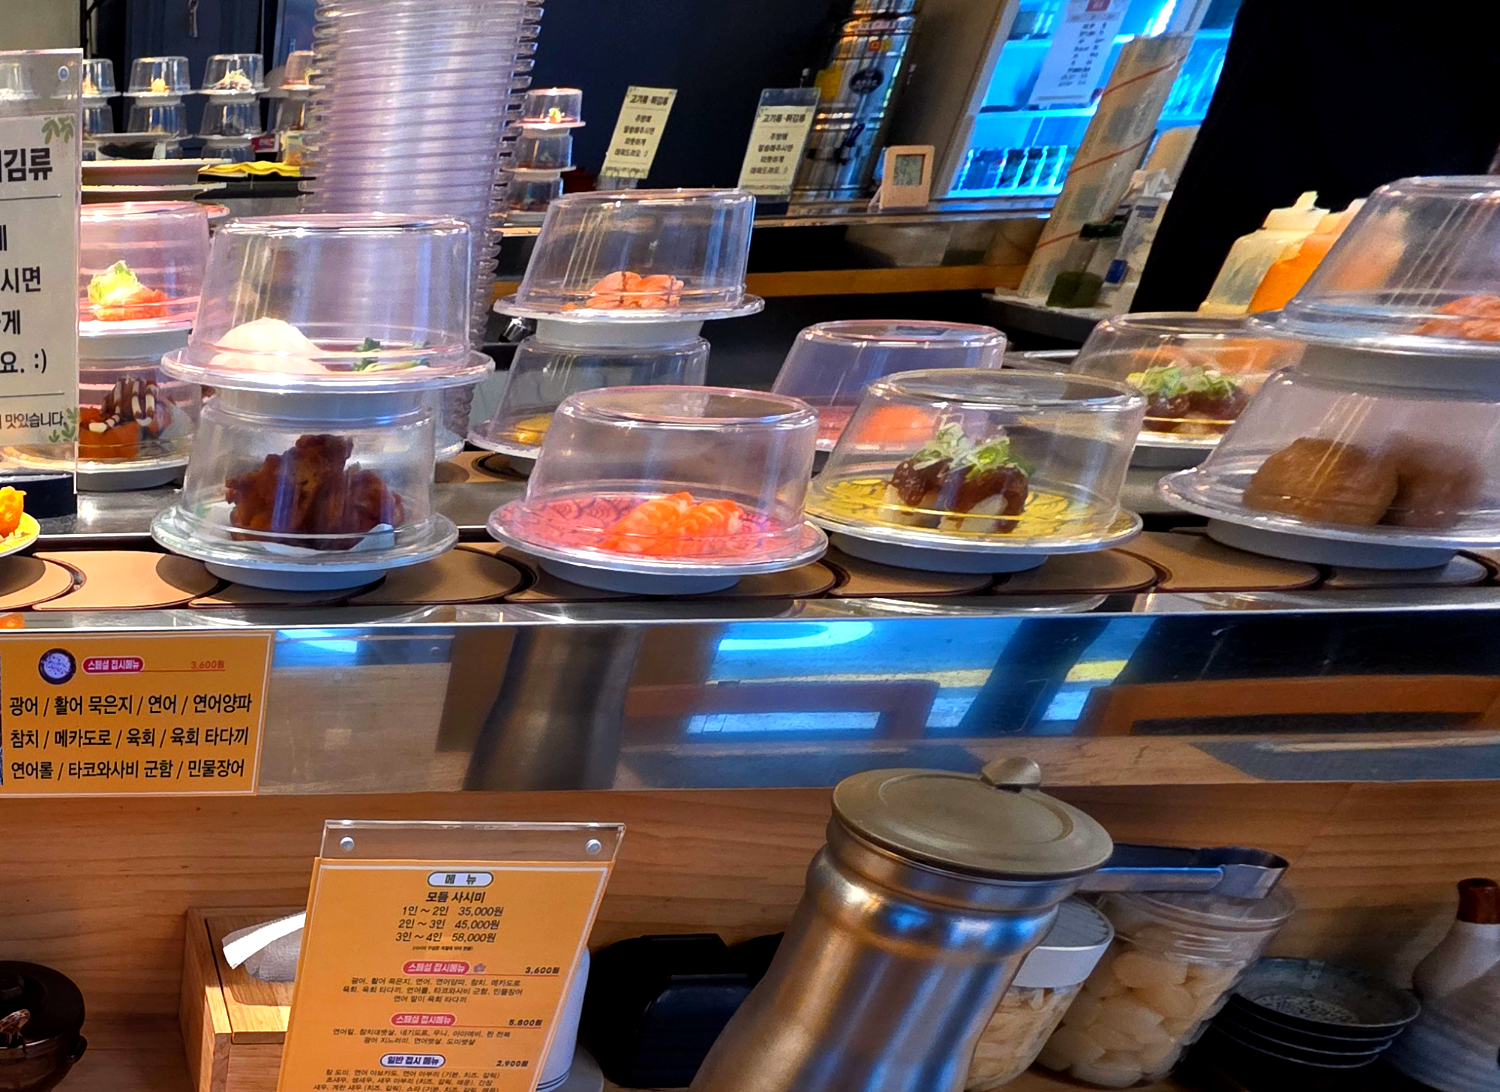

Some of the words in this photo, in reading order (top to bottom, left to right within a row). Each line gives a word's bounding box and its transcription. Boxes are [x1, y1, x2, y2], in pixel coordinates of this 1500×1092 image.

[5, 411, 67, 429] 맛있습니다.
[88, 658, 108, 671] 스페셜
[9, 696, 38, 716] 광어
[53, 695, 83, 715] 활어
[88, 695, 133, 715] 묵은지
[148, 694, 177, 714] 연어
[192, 693, 252, 714] 연어양파
[10, 729, 39, 749] 참치
[54, 728, 112, 749] 메카도로
[126, 727, 155, 747] 육회
[170, 727, 199, 747] 육회
[204, 726, 249, 747] 타다끼
[11, 761, 53, 781] 연어롤
[68, 760, 139, 780] 타코와사비
[143, 759, 173, 779] 군함
[187, 758, 245, 779] 민물장어
[451, 891, 486, 903] 사시미
[402, 906, 418, 916] 1인
[432, 906, 449, 916] 2인
[458, 906, 504, 917] 35,000원
[398, 919, 415, 929] 2인
[429, 919, 446, 930] 3인
[454, 920, 500, 930] 45,000원
[395, 932, 412, 942] 3인
[426, 932, 442, 942] 4인
[451, 933, 496, 943] 58,000원
